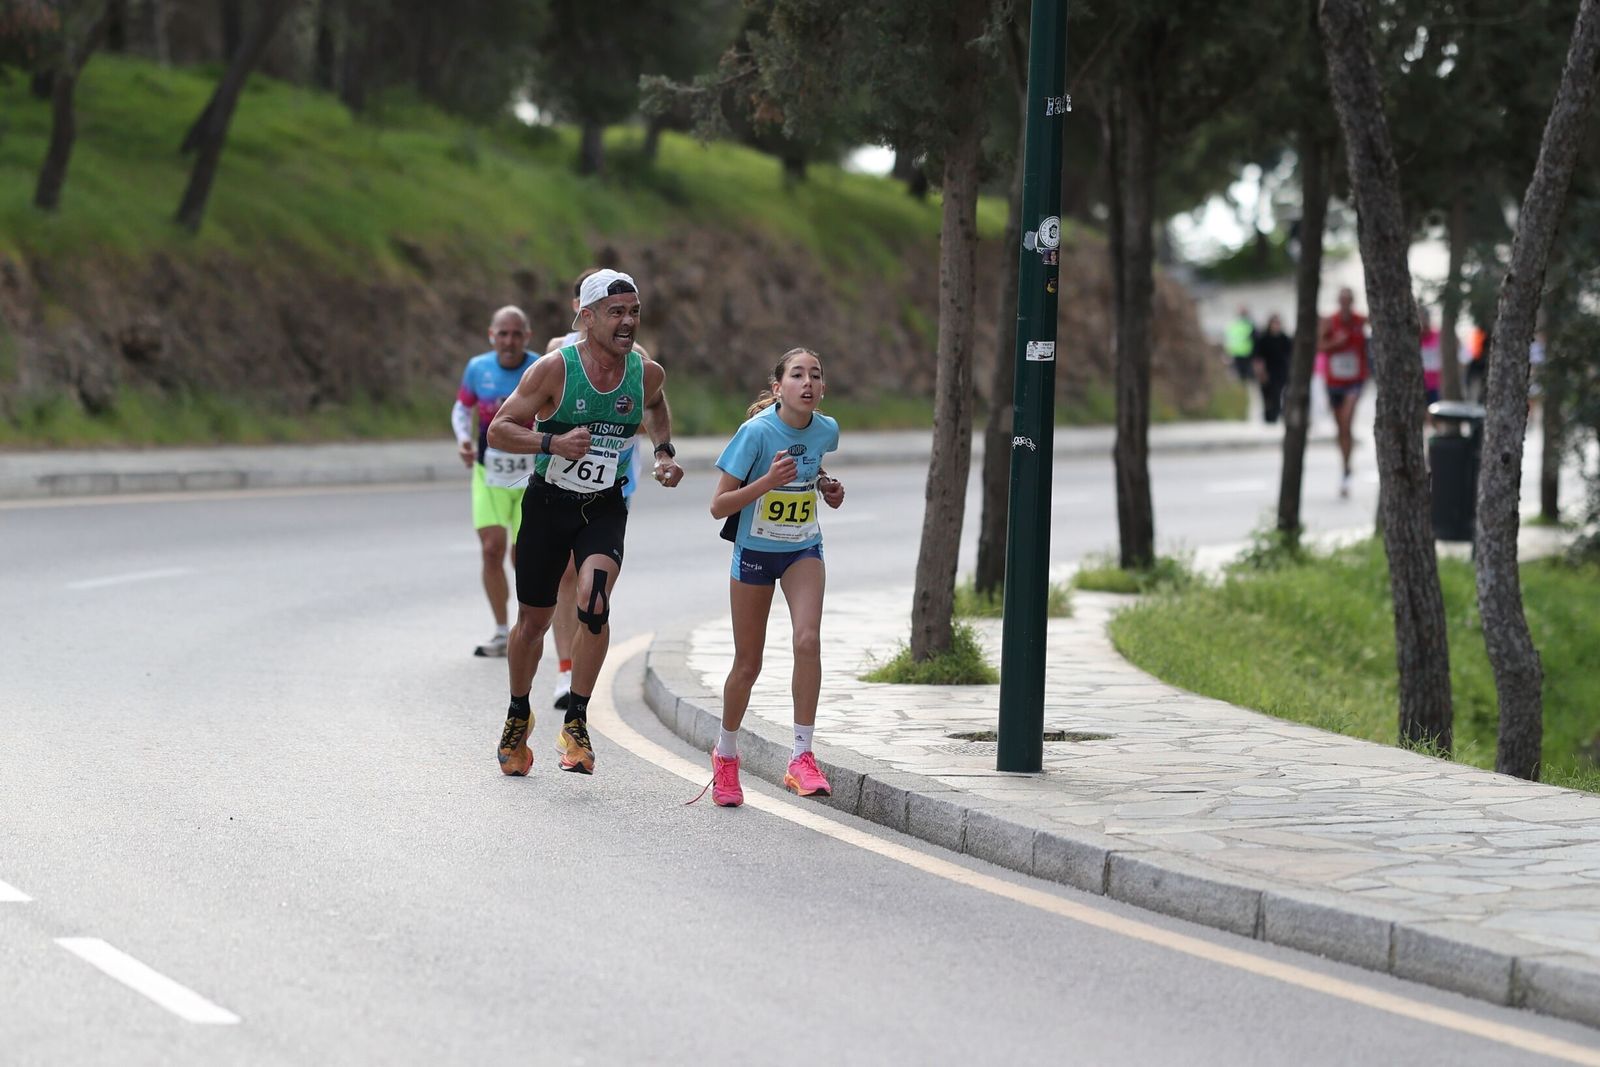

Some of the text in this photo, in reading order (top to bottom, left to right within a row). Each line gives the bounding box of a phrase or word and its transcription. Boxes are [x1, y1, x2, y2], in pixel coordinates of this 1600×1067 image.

[493, 458, 527, 473] 534
[562, 458, 606, 484] 761
[768, 500, 811, 523] 915
